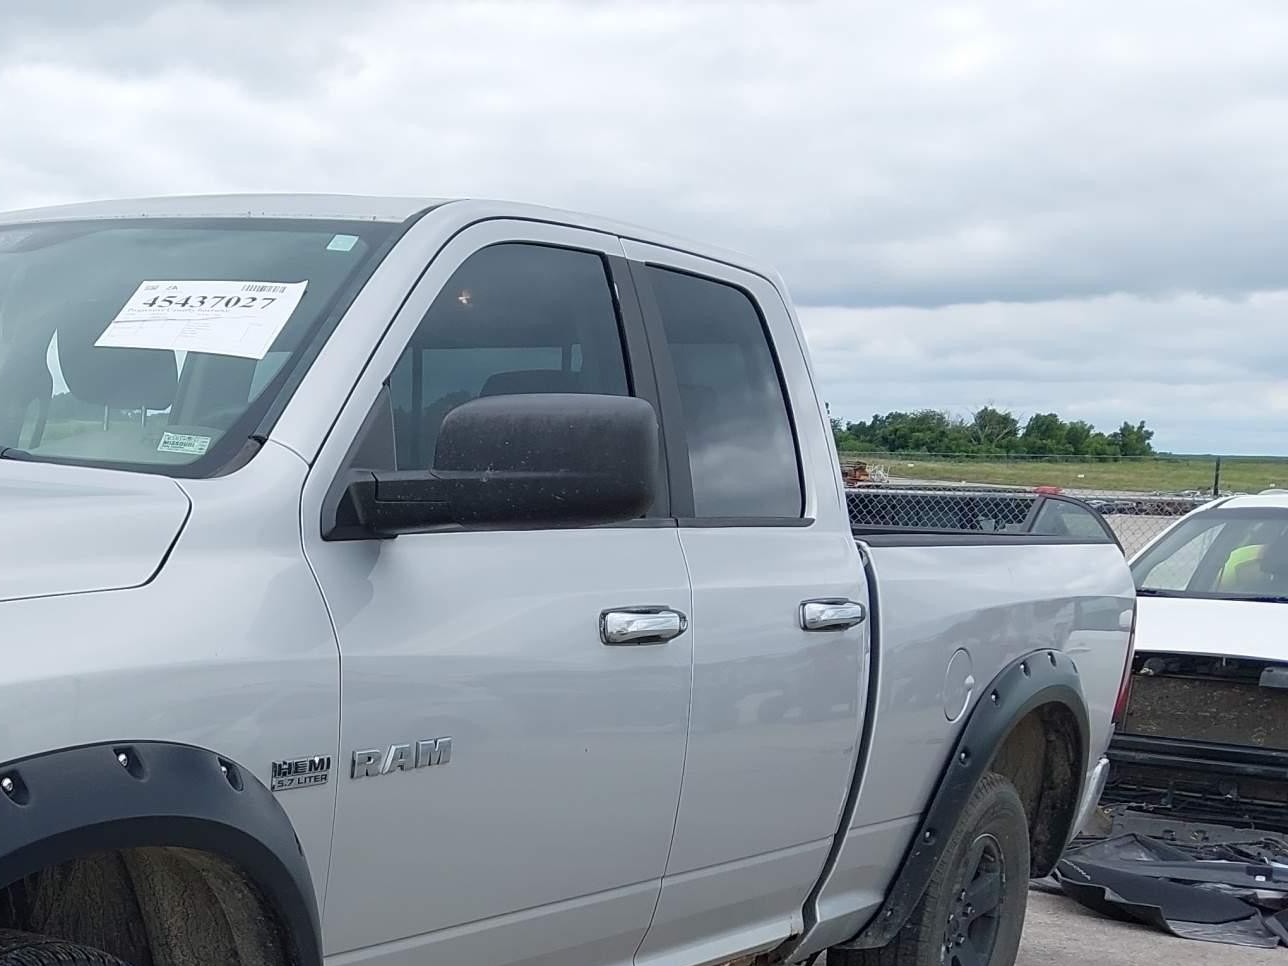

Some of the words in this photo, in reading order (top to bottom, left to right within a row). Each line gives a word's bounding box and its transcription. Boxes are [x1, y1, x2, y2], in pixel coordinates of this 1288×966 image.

[142, 295, 277, 309] 45437027
[272, 756, 331, 777] HEMI
[350, 737, 452, 779] RAM
[277, 779, 294, 788] 5.7
[297, 773, 328, 786] LITER
